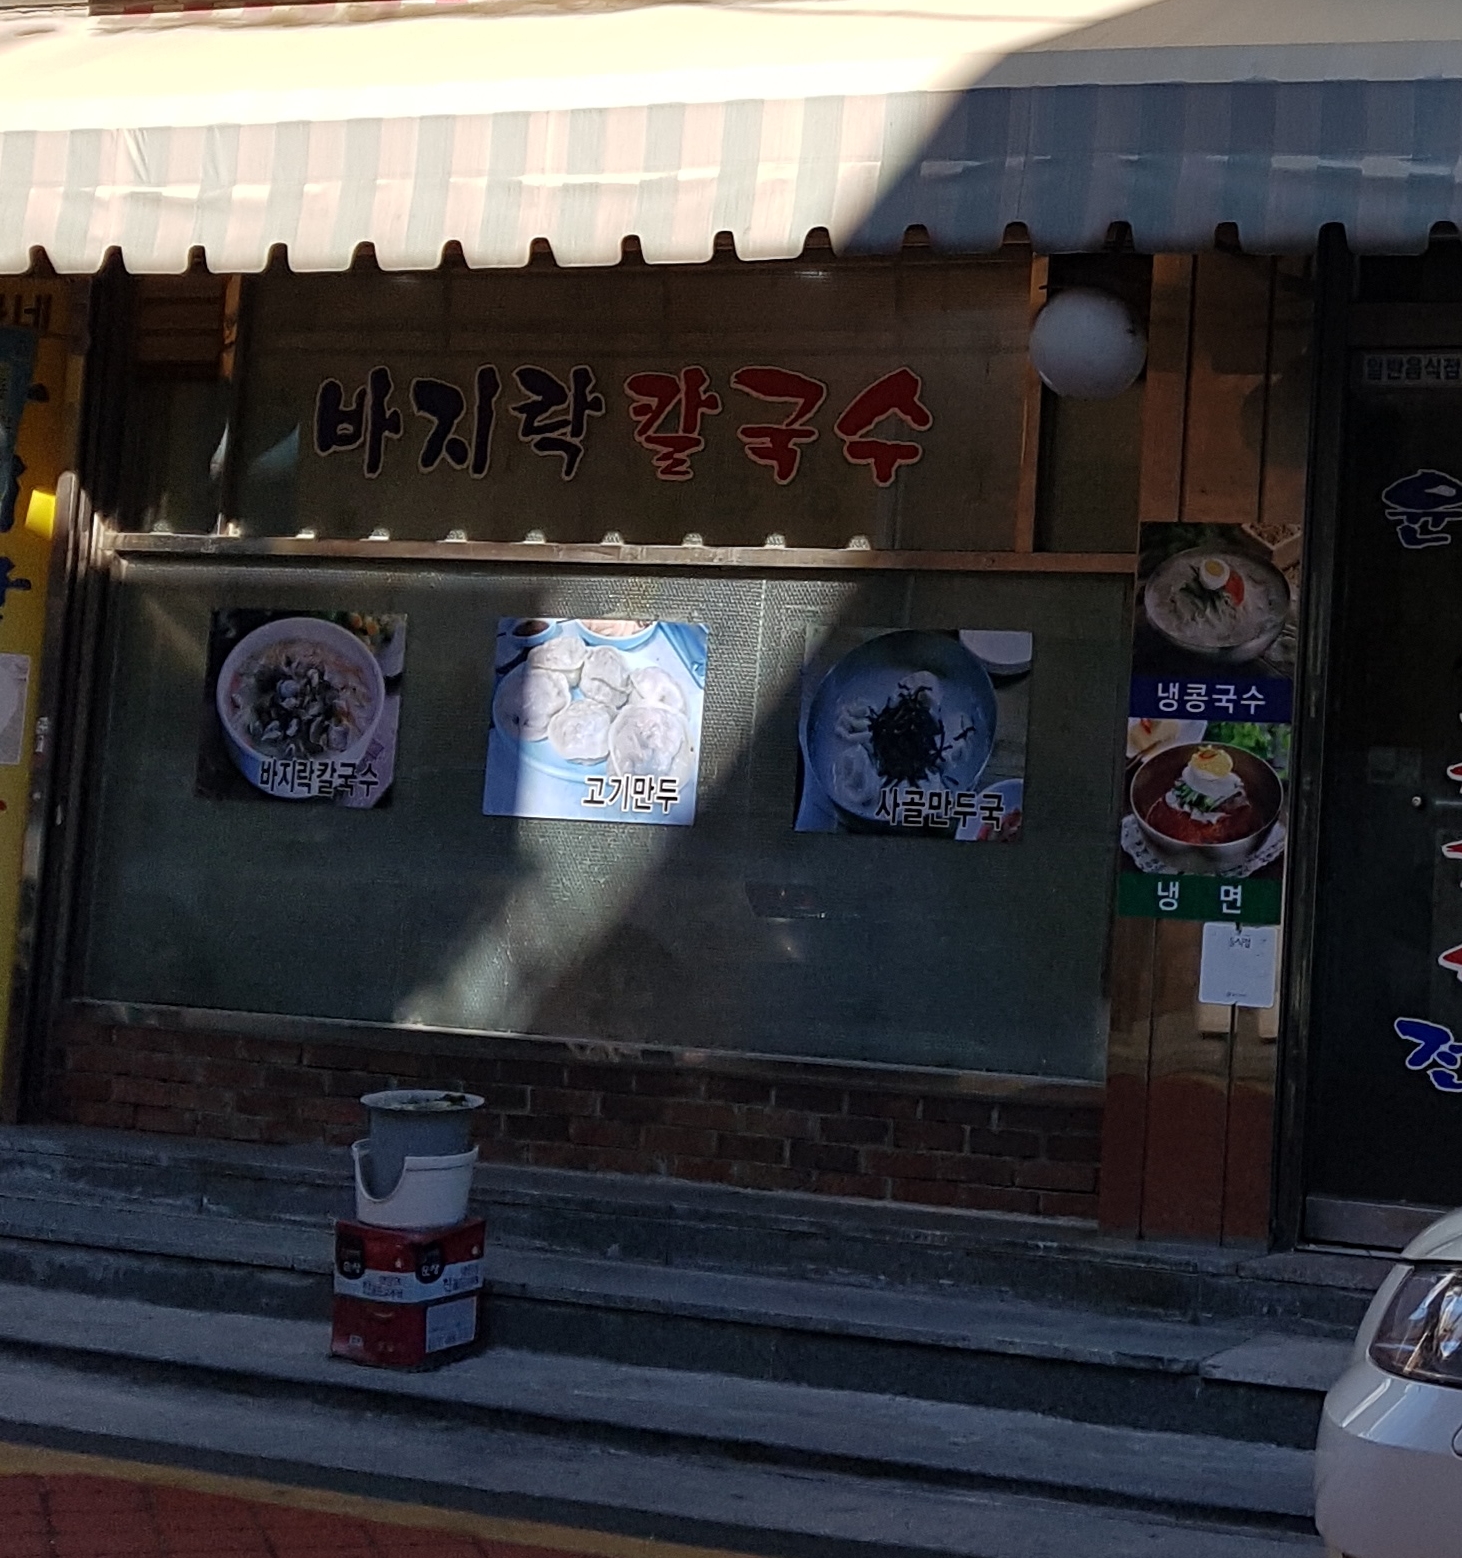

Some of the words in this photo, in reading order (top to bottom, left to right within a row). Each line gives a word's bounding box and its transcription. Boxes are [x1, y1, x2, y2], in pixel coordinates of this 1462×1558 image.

[1157, 682, 1267, 716] 냉콩국수
[259, 758, 379, 797] 바지락칼국수
[583, 773, 681, 816] 고기만두
[875, 788, 1005, 831] 사골만두국
